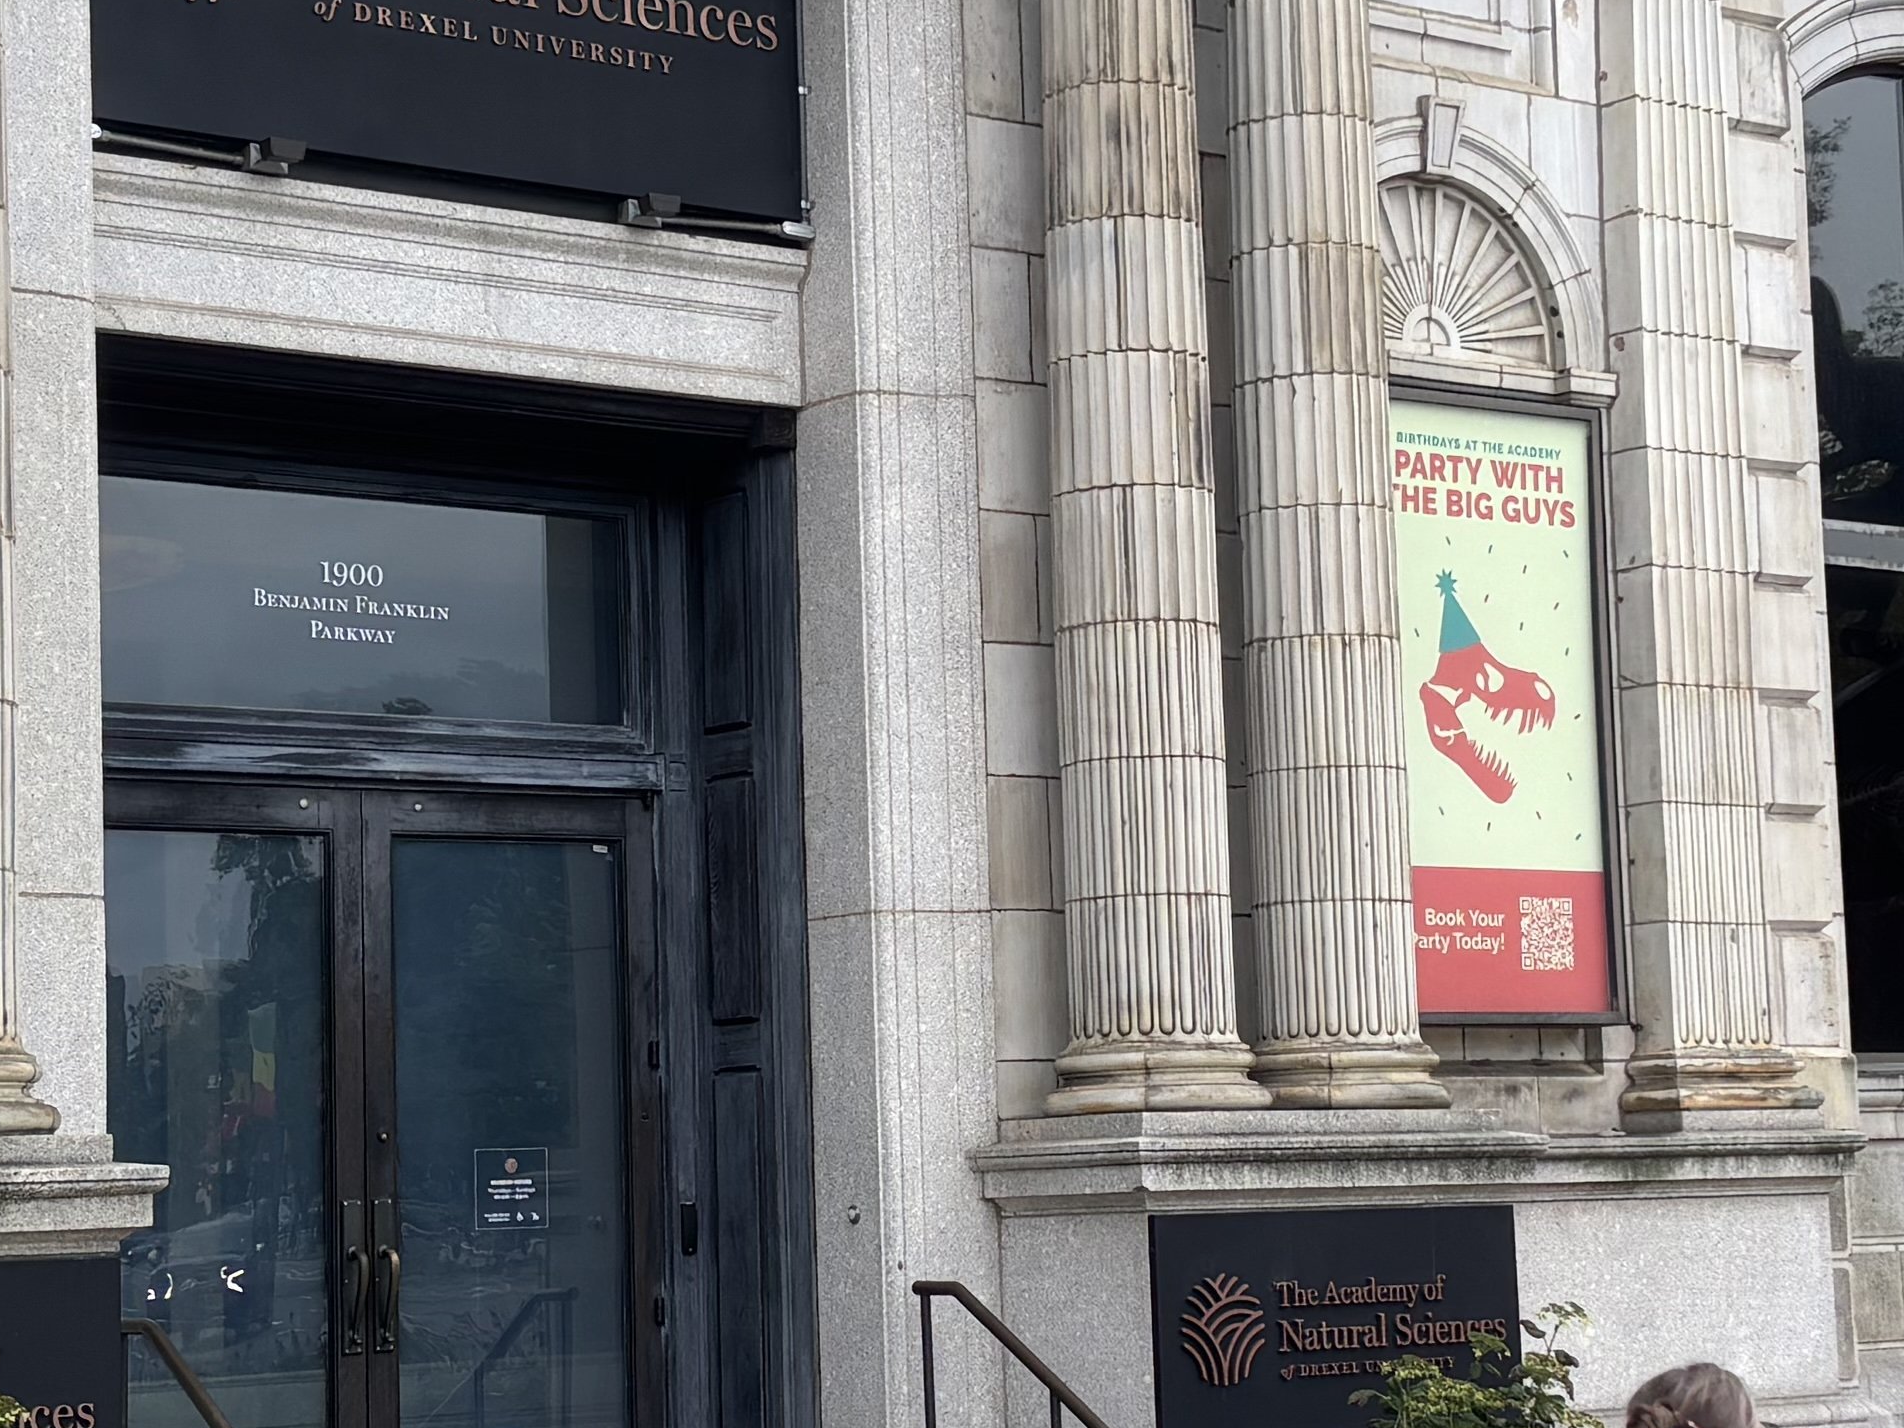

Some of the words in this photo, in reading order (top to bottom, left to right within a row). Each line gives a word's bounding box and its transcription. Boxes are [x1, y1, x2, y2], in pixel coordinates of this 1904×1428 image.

[353, 1, 478, 42] DREXEL
[491, 24, 675, 75] UNIVERSITY
[1396, 431, 1461, 449] BIRTHDAYS
[1464, 440, 1478, 451] AT
[1481, 441, 1504, 454] THE
[1507, 444, 1561, 461] ACADEMY
[1395, 449, 1483, 485] PARTY
[1490, 459, 1563, 494] WITH
[1446, 488, 1494, 520] BIG
[1501, 495, 1576, 528] GUYS
[320, 561, 384, 587] 1900
[1425, 907, 1466, 927] Book
[1468, 909, 1505, 927] Your
[1452, 932, 1505, 954] Today!
[1275, 1280, 1319, 1306] The
[1320, 1277, 1419, 1307] Academy
[1423, 1274, 1446, 1301] of
[1278, 1312, 1388, 1353] Natural
[1395, 1312, 1507, 1345] Sciences
[1280, 1363, 1295, 1381] of
[1299, 1361, 1360, 1376] DREXEL
